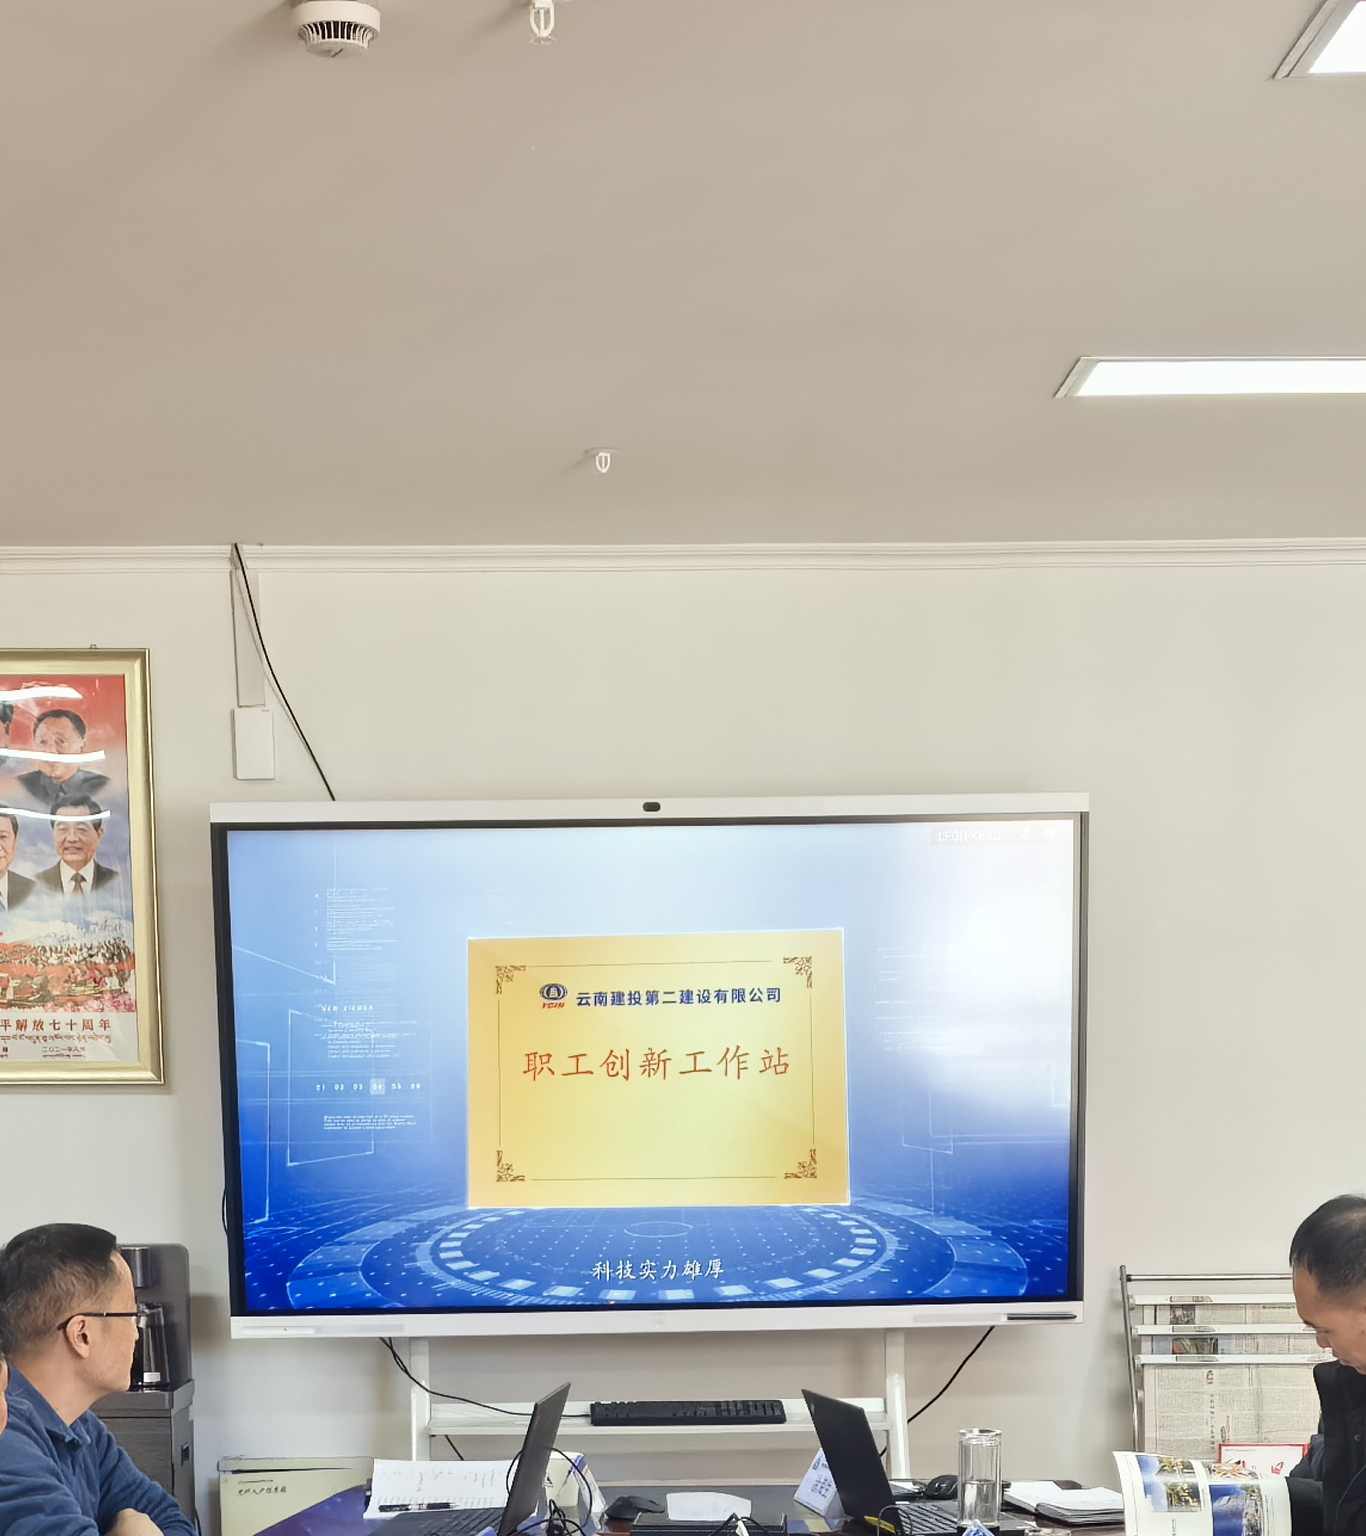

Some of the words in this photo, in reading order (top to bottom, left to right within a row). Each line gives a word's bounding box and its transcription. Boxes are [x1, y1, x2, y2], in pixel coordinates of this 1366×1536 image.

[576, 986, 781, 1007] 云南建投第二建设有限公司
[522, 1044, 790, 1082] 职工创新工作站
[591, 1258, 725, 1282] 科技实力雄厚
